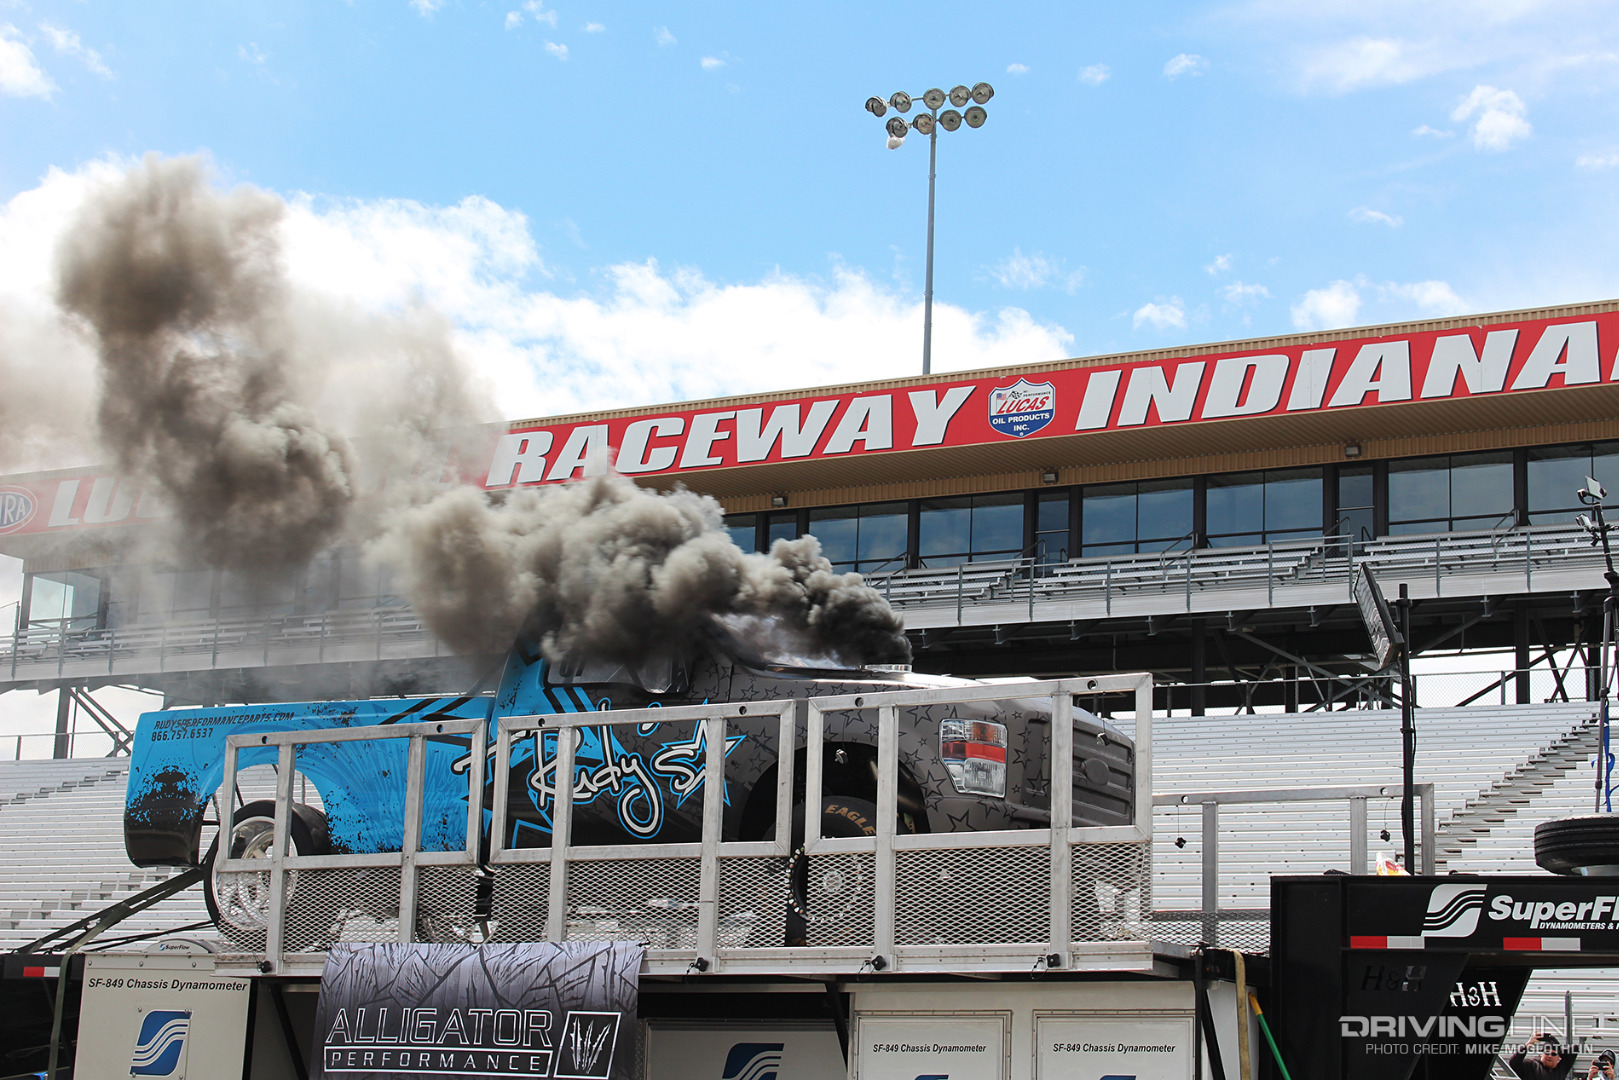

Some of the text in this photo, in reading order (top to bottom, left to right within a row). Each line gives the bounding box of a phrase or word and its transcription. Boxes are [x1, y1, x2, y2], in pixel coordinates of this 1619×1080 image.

[996, 396, 1049, 414] LUCAS
[992, 413, 1050, 425] OIL PRODUCTS
[485, 385, 977, 487] RACEWAY
[1013, 424, 1030, 432] INC.
[0, 493, 28, 528] RA
[153, 711, 295, 731] RUDYSPERFORMANCEPARTS.COM
[151, 728, 213, 742] 866.757.6537
[825, 804, 877, 836] EAGLE
[1540, 922, 1606, 930] DYNAMOMETERS
[88, 977, 248, 992] SF-849 Chassis Dynamometer
[325, 1007, 553, 1048] ALLIGATOR
[872, 1043, 987, 1054] SF-849 Chassis Dynamometer
[1052, 1043, 1176, 1055] SF-849 Chassis Dynamometer
[331, 1051, 541, 1072] PERFORMANCE
